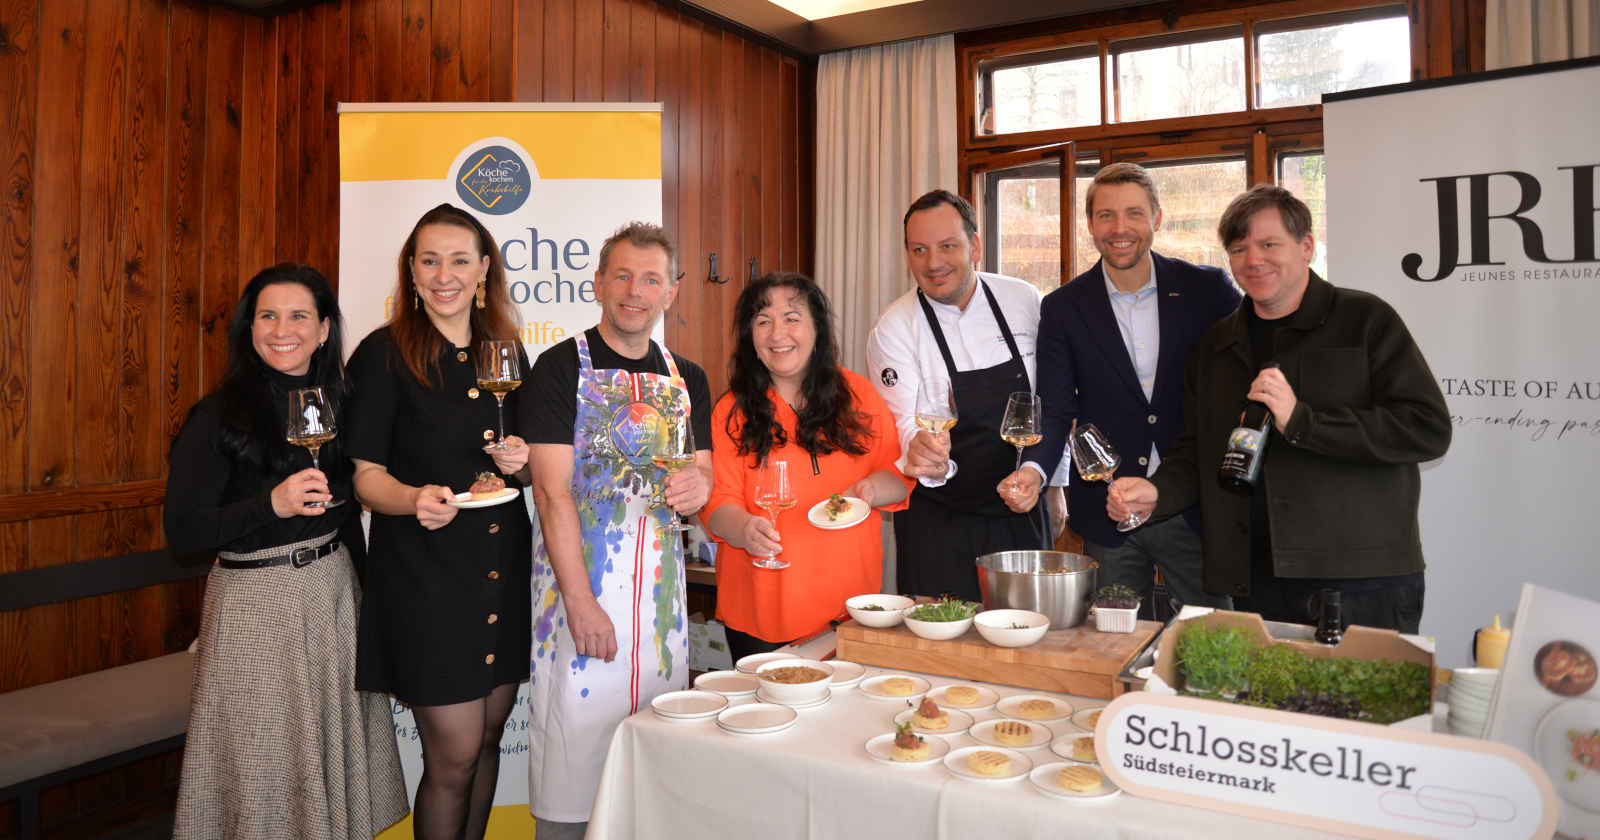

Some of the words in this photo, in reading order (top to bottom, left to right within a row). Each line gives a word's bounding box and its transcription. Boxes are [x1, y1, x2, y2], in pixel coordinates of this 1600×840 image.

[478, 167, 509, 177] Köche
[501, 227, 590, 271] che
[509, 272, 596, 304] oche
[1460, 271, 1516, 282] JEUNES
[1442, 378, 1518, 398] TASTE
[1523, 381, 1559, 399] OF
[1124, 714, 1417, 790] Schlosskeller
[1123, 751, 1277, 794] Südsteiermark
